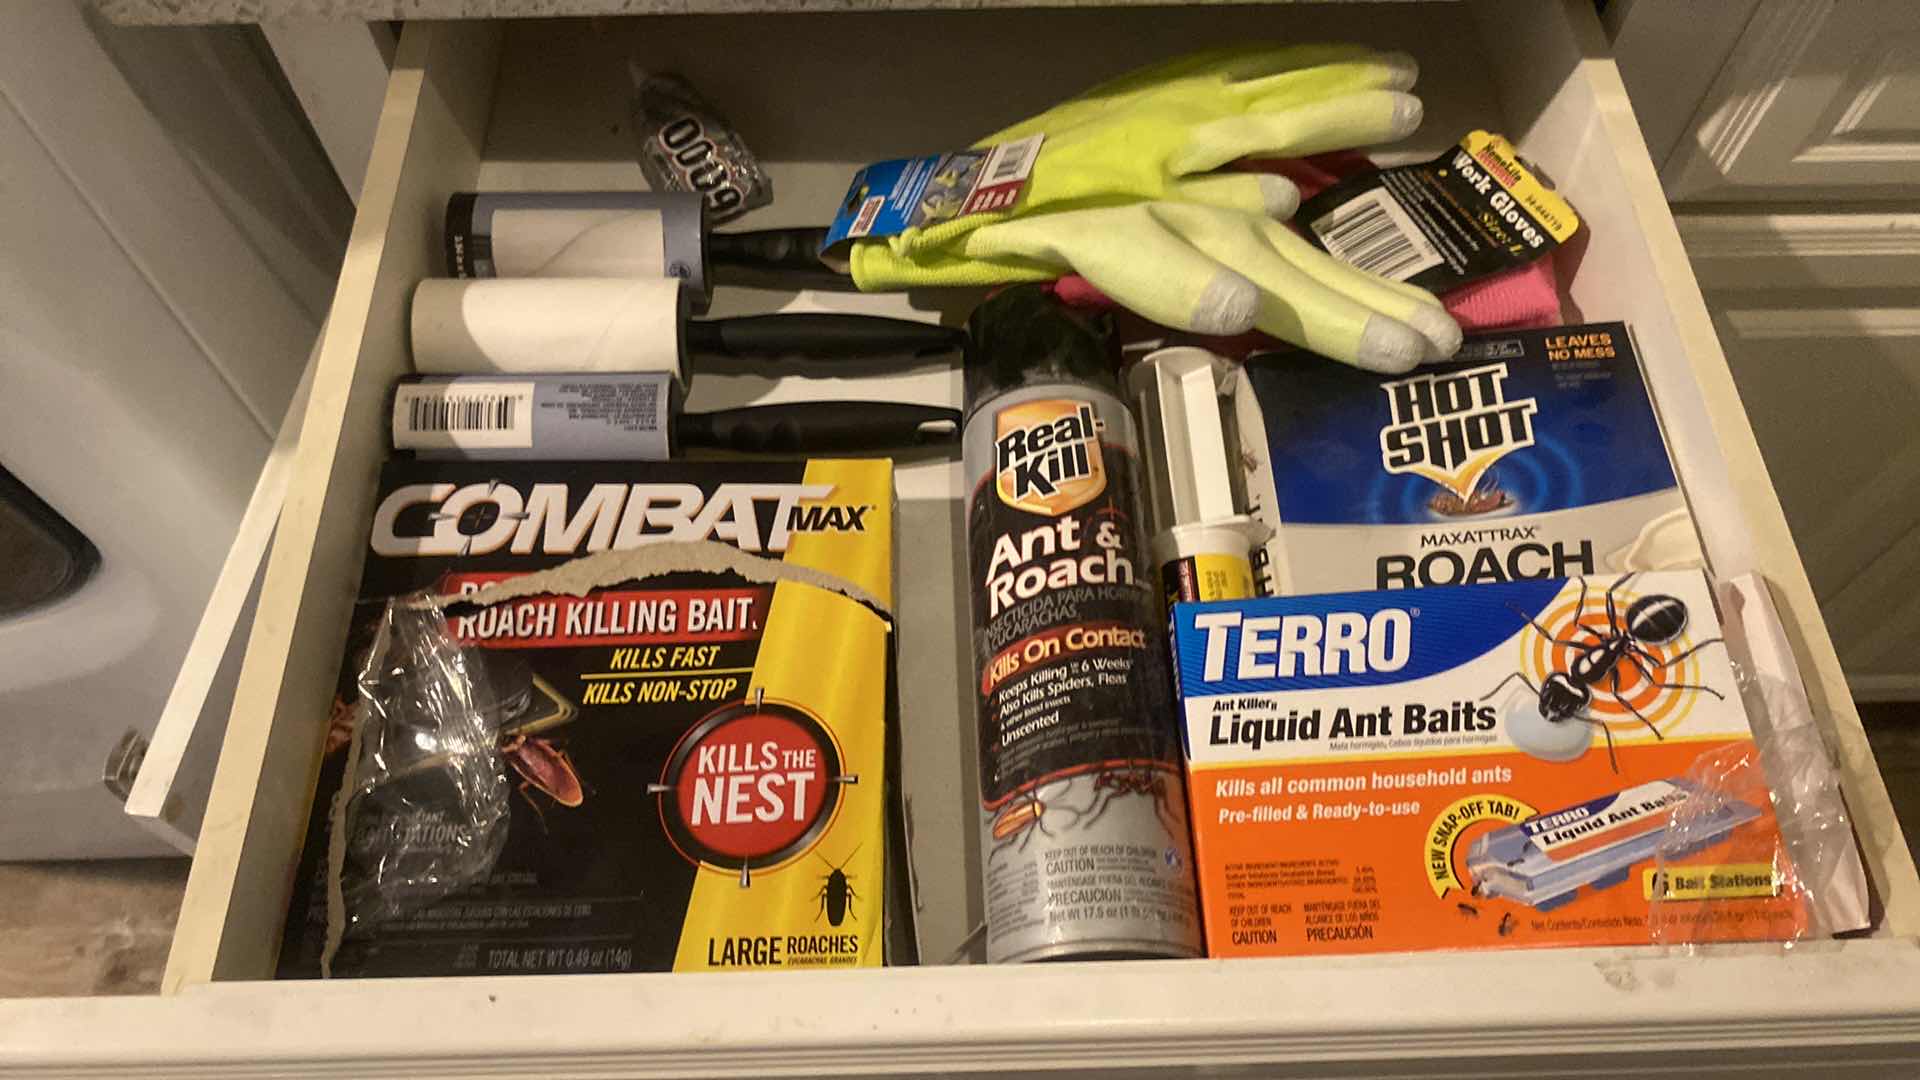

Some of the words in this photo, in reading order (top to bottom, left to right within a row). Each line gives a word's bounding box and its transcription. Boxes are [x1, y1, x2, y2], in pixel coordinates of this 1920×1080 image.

[1452, 151, 1492, 195] Work
[1490, 186, 1546, 249] Gloves
[1545, 333, 1613, 349] LEAVES
[1548, 349, 1571, 361] NO
[1574, 346, 1616, 359] MESS
[1387, 366, 1507, 426] HOT
[1383, 402, 1536, 472] SHOT
[1013, 443, 1091, 499] Kill
[369, 482, 839, 557] COMBAT
[787, 505, 868, 532] MAX
[985, 515, 1081, 586] Ant
[1096, 521, 1122, 549] &
[1420, 526, 1535, 548] MAXATTRAX
[1376, 540, 1594, 591] ROACH
[989, 549, 1135, 619] Roach
[1057, 584, 1096, 607] PARA
[564, 598, 677, 636] KILLING
[610, 647, 667, 670] KILLS
[670, 645, 721, 668] FAST
[989, 651, 1020, 689] Kills
[1024, 637, 1060, 664] On
[1066, 626, 1146, 651] Contact
[1195, 608, 1412, 683] TERRO
[582, 681, 636, 705] KILLS
[637, 677, 738, 703] NON-STOP
[999, 680, 1028, 705] Keeps
[1030, 663, 1068, 687] Killing
[1081, 660, 1090, 673] 6
[999, 701, 1020, 720] Also
[1022, 688, 1046, 707] Kills
[1213, 700, 1235, 712] Ant
[1238, 698, 1271, 711] Killer
[1001, 711, 1060, 747] Unscented
[1209, 709, 1321, 750] Liquid
[1328, 706, 1392, 739] Ant
[1403, 700, 1497, 736] Baits
[698, 741, 779, 774] KILLS
[782, 749, 816, 769] THE
[1215, 778, 1255, 798] Kills
[1260, 777, 1283, 797] all
[1287, 775, 1366, 795] common
[1372, 767, 1467, 791] household
[1471, 765, 1512, 786] ants
[691, 771, 816, 826] NEST
[1218, 806, 1293, 825] Pre-filled
[1296, 805, 1308, 821] &
[1312, 801, 1421, 823] Ready-to-use
[1487, 800, 1521, 820] TAB!
[1433, 801, 1485, 850] SNAP-OFF
[1524, 807, 1590, 835] TERRO
[1543, 818, 1605, 846] Liquid
[1608, 809, 1640, 825] Ant
[1045, 858, 1095, 875] CAUTION
[1431, 850, 1447, 881] NEW
[1232, 930, 1277, 945] CAUTION
[1306, 923, 1374, 942] PRECAUCIÓN
[488, 949, 520, 969] TOTAL
[521, 949, 545, 968] NET
[546, 949, 566, 968] WT
[708, 937, 783, 966] LARGE
[787, 935, 858, 954] ROACHES
